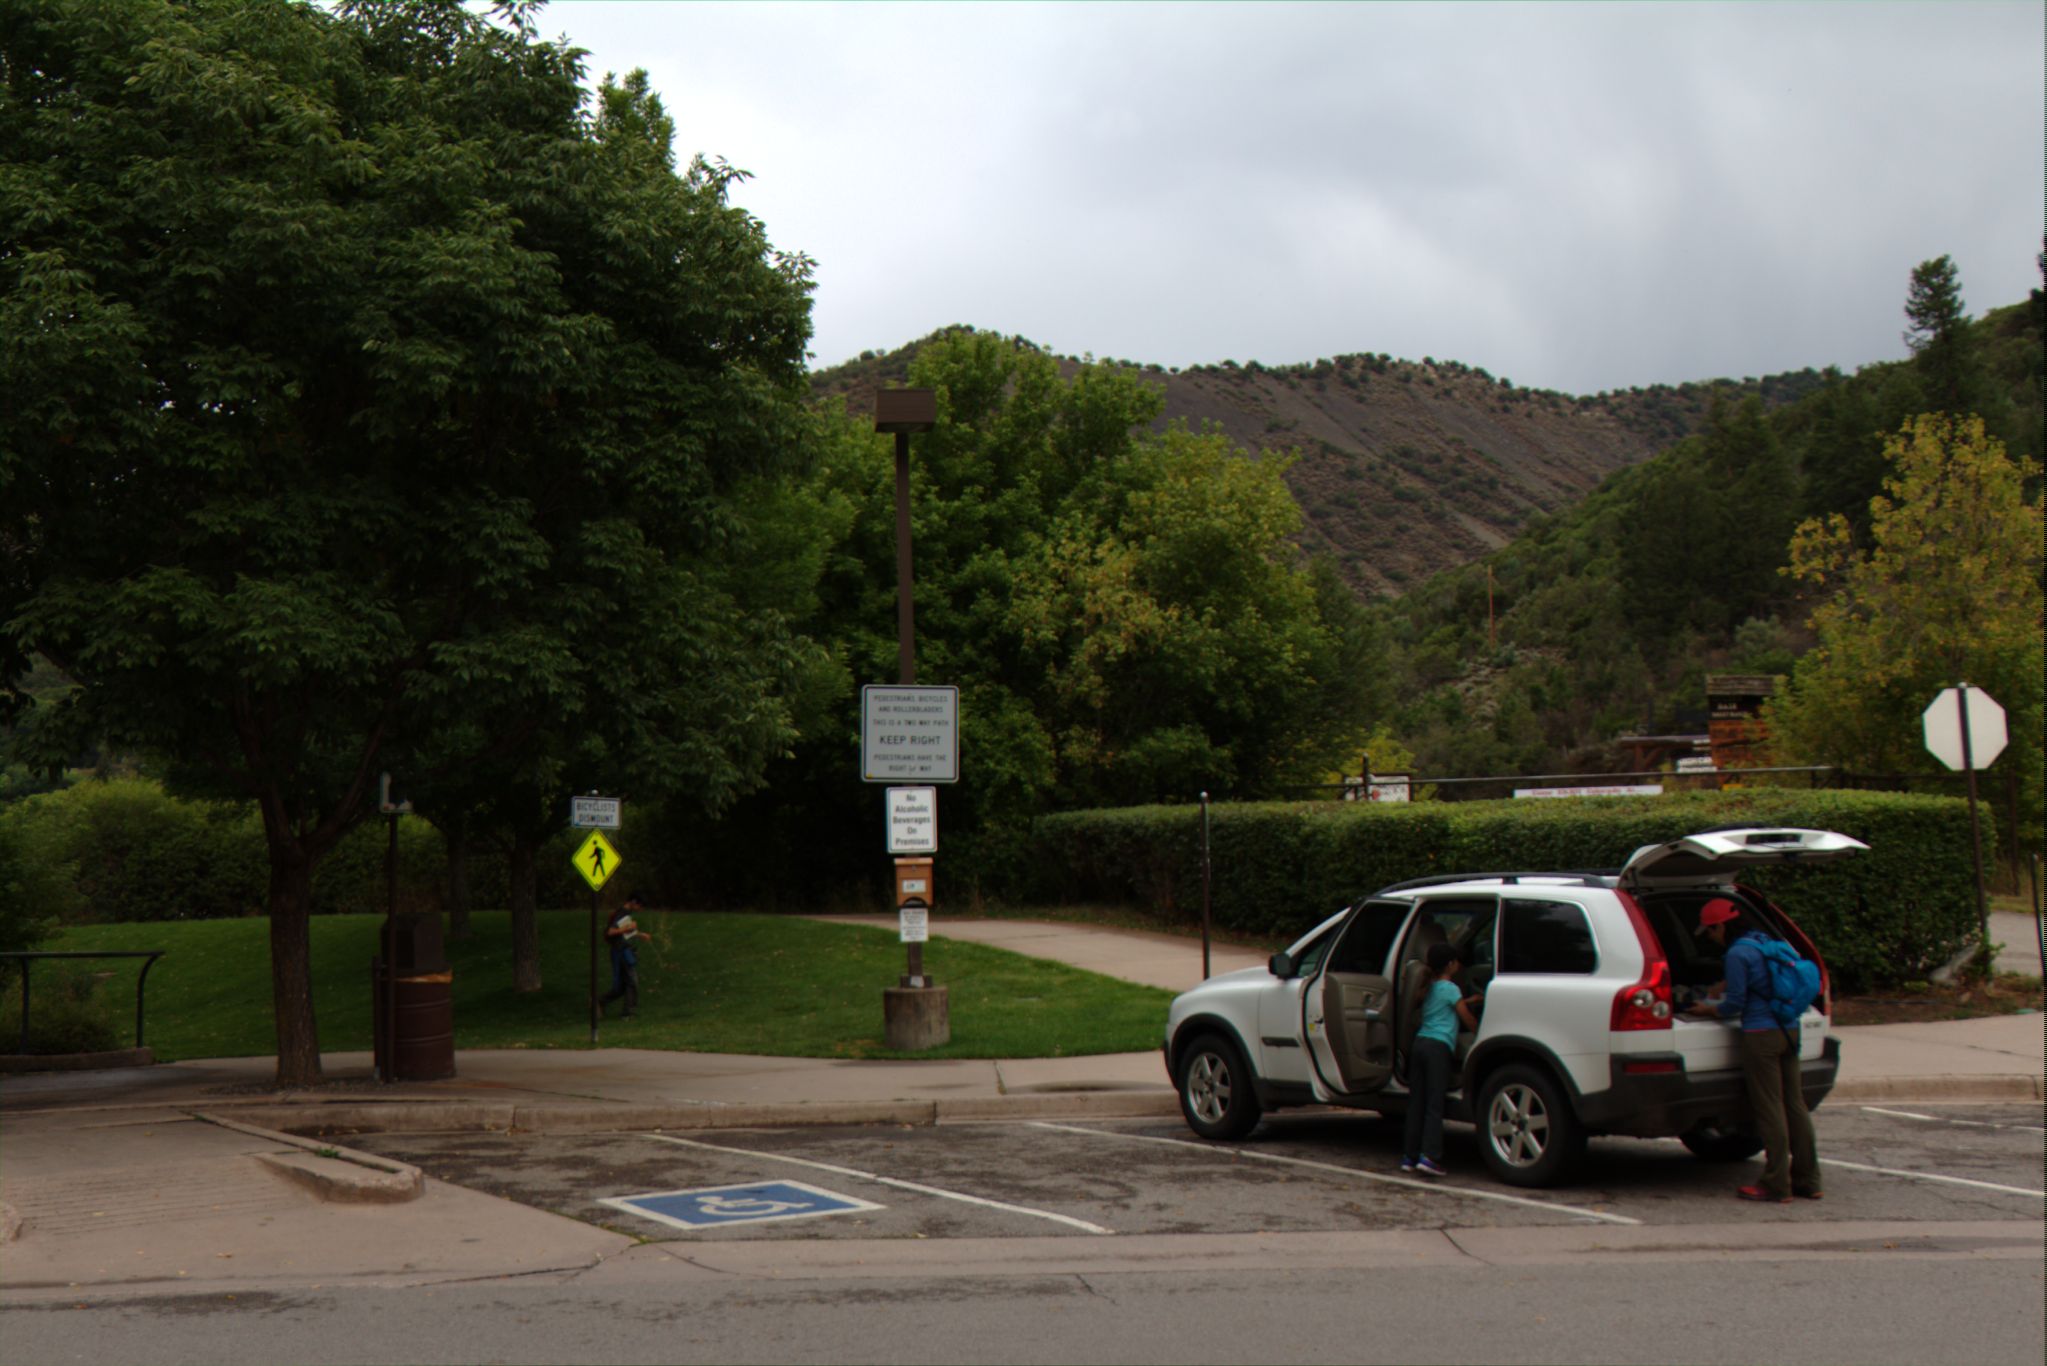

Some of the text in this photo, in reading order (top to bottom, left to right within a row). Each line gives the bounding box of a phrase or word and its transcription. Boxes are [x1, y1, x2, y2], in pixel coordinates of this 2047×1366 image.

[880, 735, 942, 745] KEEP RIGHT
[906, 794, 916, 802] No
[895, 805, 929, 813] Alcoholic
[893, 816, 931, 825] Beverages
[907, 826, 917, 834] On
[895, 838, 929, 846] Premises
